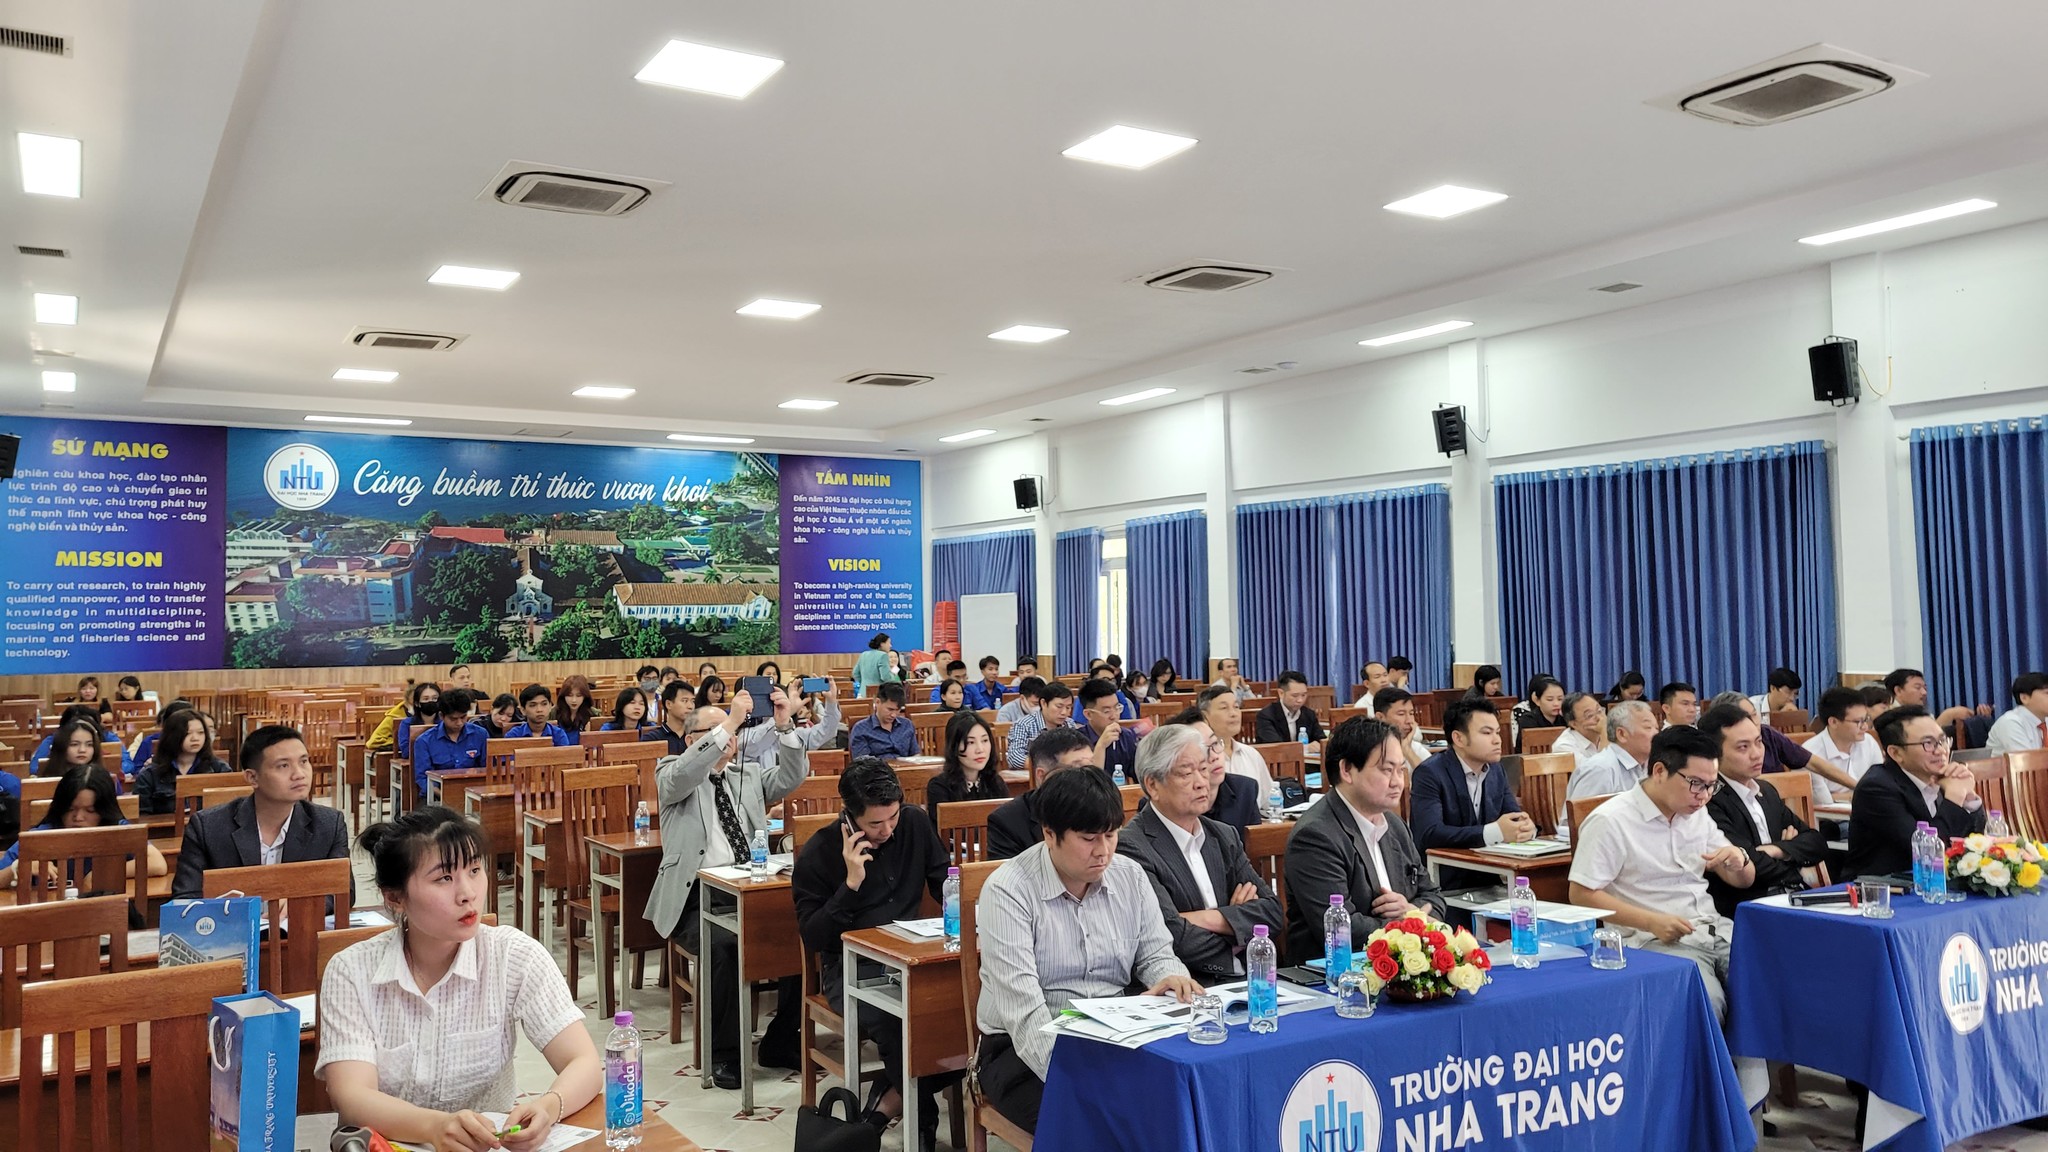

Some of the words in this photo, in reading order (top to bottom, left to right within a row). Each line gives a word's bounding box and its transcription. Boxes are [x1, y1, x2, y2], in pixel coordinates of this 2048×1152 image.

[52, 437, 86, 456] SỨ
[92, 441, 169, 461] MẠNG
[78, 471, 104, 479] khoa
[110, 472, 132, 481] học,
[137, 472, 156, 481] đào
[161, 474, 177, 482] tạo
[181, 474, 207, 482] nhân
[284, 476, 319, 490] NTU
[354, 459, 425, 506] Căng
[432, 467, 503, 497] buồm
[509, 472, 542, 498] tri
[546, 472, 595, 499] thức
[603, 480, 656, 500] vươn
[662, 476, 711, 502] khơi
[852, 472, 890, 487] NHÌN
[8, 482, 25, 491] lực
[63, 483, 77, 493] độ
[107, 484, 119, 493] và
[169, 486, 191, 496] giao
[8, 495, 33, 503] thức
[37, 496, 50, 504] đa
[129, 498, 157, 508] trọng
[161, 499, 184, 508] phát
[188, 500, 207, 509] huy
[32, 510, 62, 518] mạnh
[94, 511, 112, 520] vực
[118, 511, 143, 519] khoa
[148, 512, 168, 520] học
[181, 512, 207, 522] công
[8, 522, 36, 532] nghệ
[65, 523, 76, 531] và
[55, 551, 162, 567] MISSION
[828, 559, 880, 571] VISION
[7, 582, 20, 590] To
[24, 583, 53, 591] carry
[78, 582, 129, 591] research,
[146, 582, 170, 590] train
[174, 581, 206, 592] highly
[6, 595, 55, 604] qualified
[60, 596, 120, 604] manpower,
[125, 594, 145, 603] and
[165, 594, 206, 603] transfer
[6, 608, 78, 618] knowledge
[86, 608, 98, 616] in
[106, 607, 206, 617] multidiscipline,
[6, 622, 55, 631] focusing
[79, 621, 135, 631] promoting
[140, 620, 191, 630] strengths
[196, 620, 206, 628] in
[6, 634, 46, 643] marine
[52, 634, 74, 643] and
[81, 634, 130, 642] fisheries
[137, 634, 179, 642] science
[185, 632, 206, 641] and
[6, 648, 70, 658] technology.
[1990, 938, 2048, 972] TRƯỜNG
[1952, 984, 1978, 1005] NTU
[1996, 973, 2043, 1014] NHA
[1390, 1054, 1504, 1108] TRƯỜNG
[1513, 1046, 1560, 1087] ĐẠI
[1568, 1033, 1624, 1076] HỌC
[620, 1065, 635, 1112] Vikoda
[1395, 1100, 1484, 1152] NHA
[1497, 1072, 1624, 1138] TRANG
[1306, 1125, 1358, 1152] NTU
